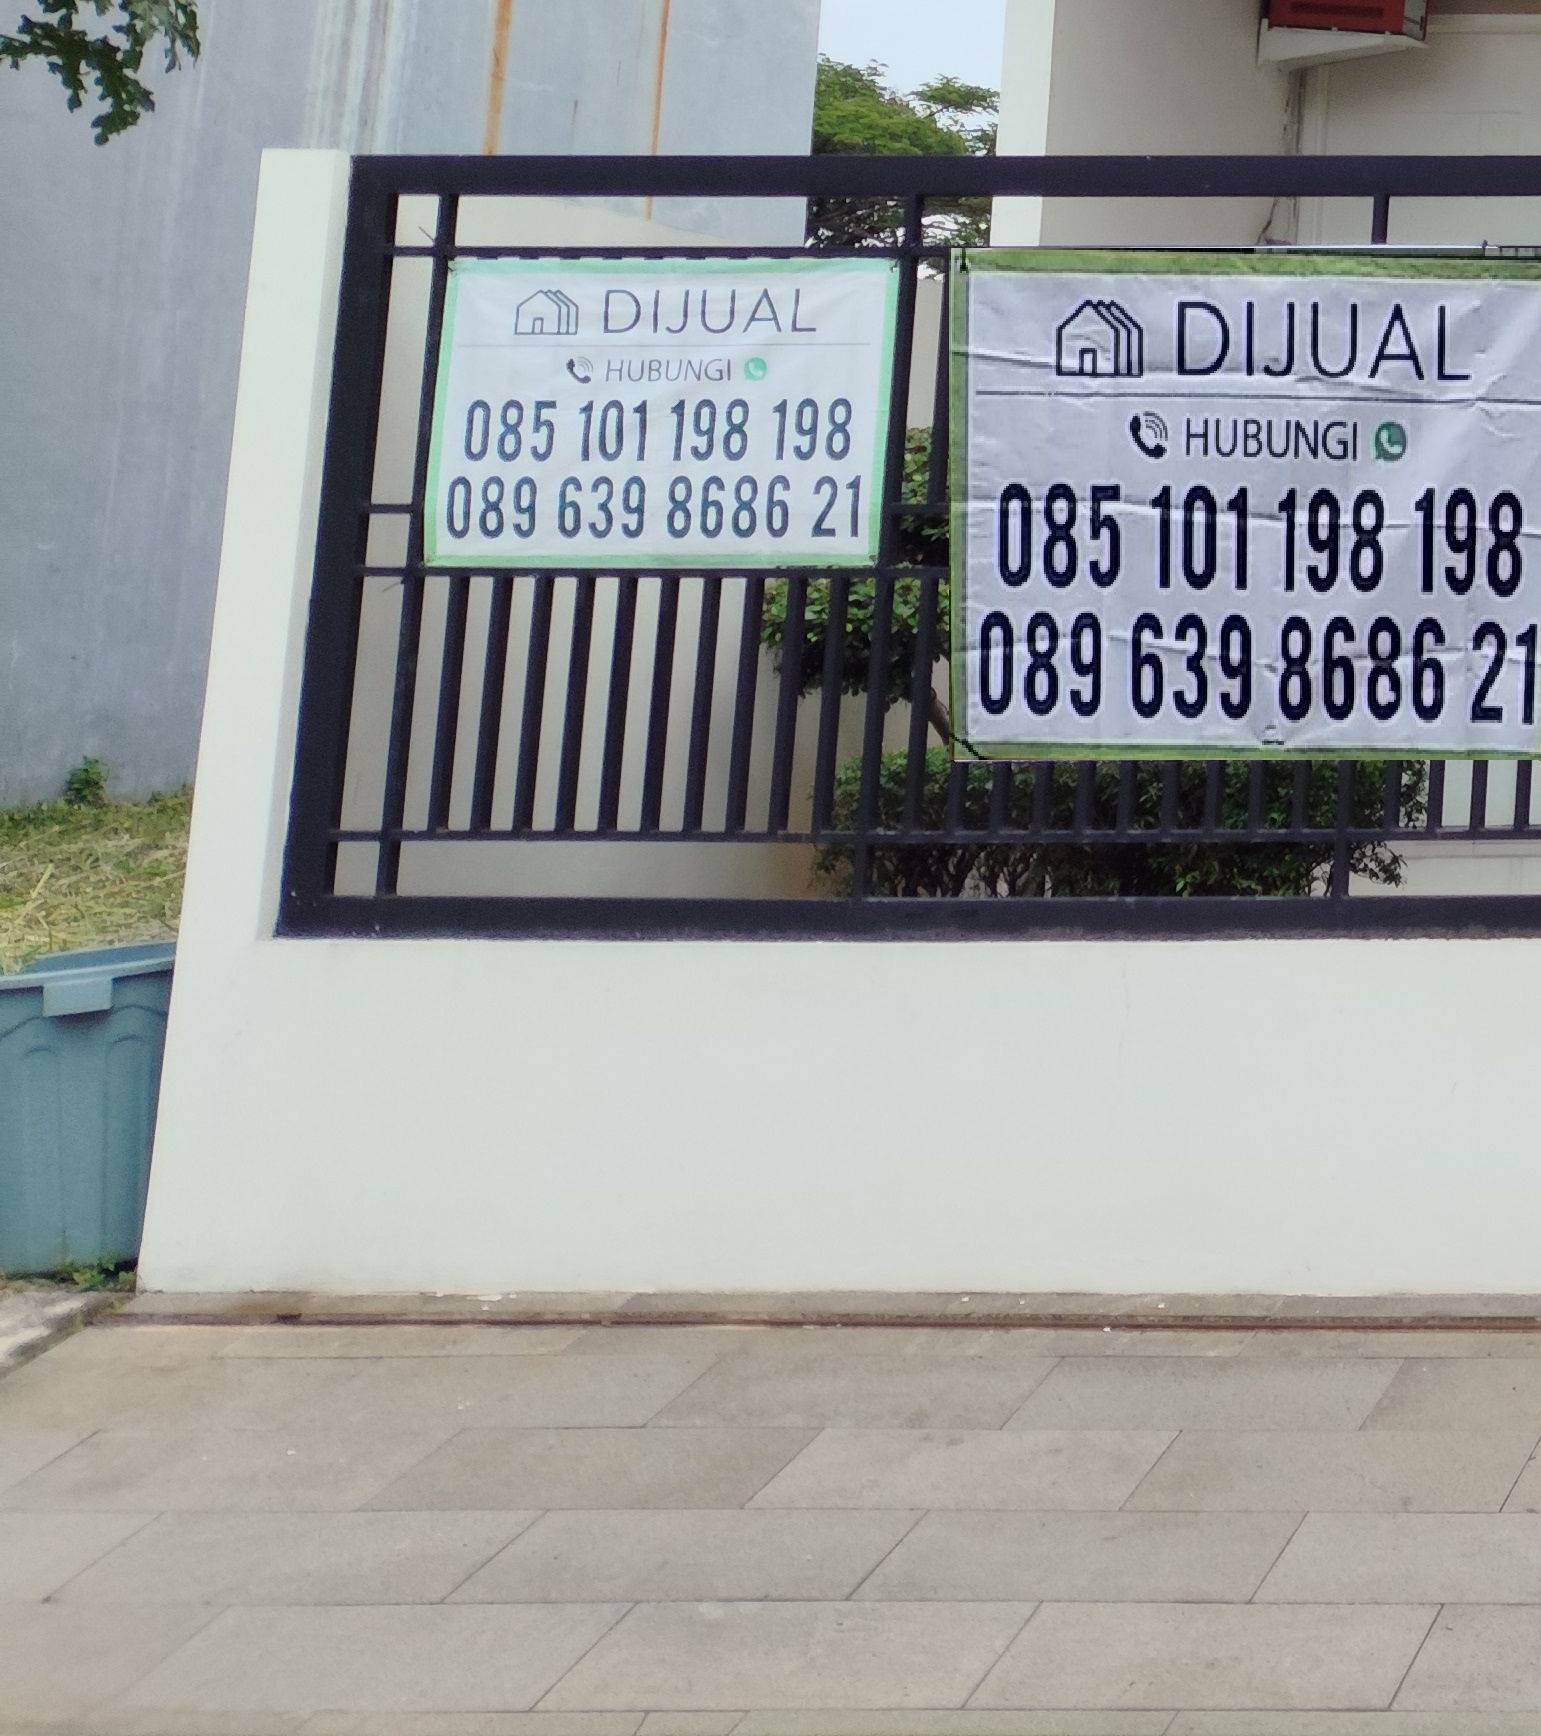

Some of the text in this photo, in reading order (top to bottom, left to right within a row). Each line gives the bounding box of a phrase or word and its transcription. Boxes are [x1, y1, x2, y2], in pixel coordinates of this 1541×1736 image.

[602, 287, 818, 335] DIJUAL
[1176, 300, 1472, 382] DIJUAL
[605, 357, 732, 383] HUBUNGI
[463, 396, 853, 464] 085 101 198 198
[1184, 416, 1359, 463] HUBUNGI
[446, 473, 863, 541] 089 639 8686 21
[998, 482, 1524, 599] 085 101 198 198
[979, 609, 1539, 727] 089 639 8686 21
